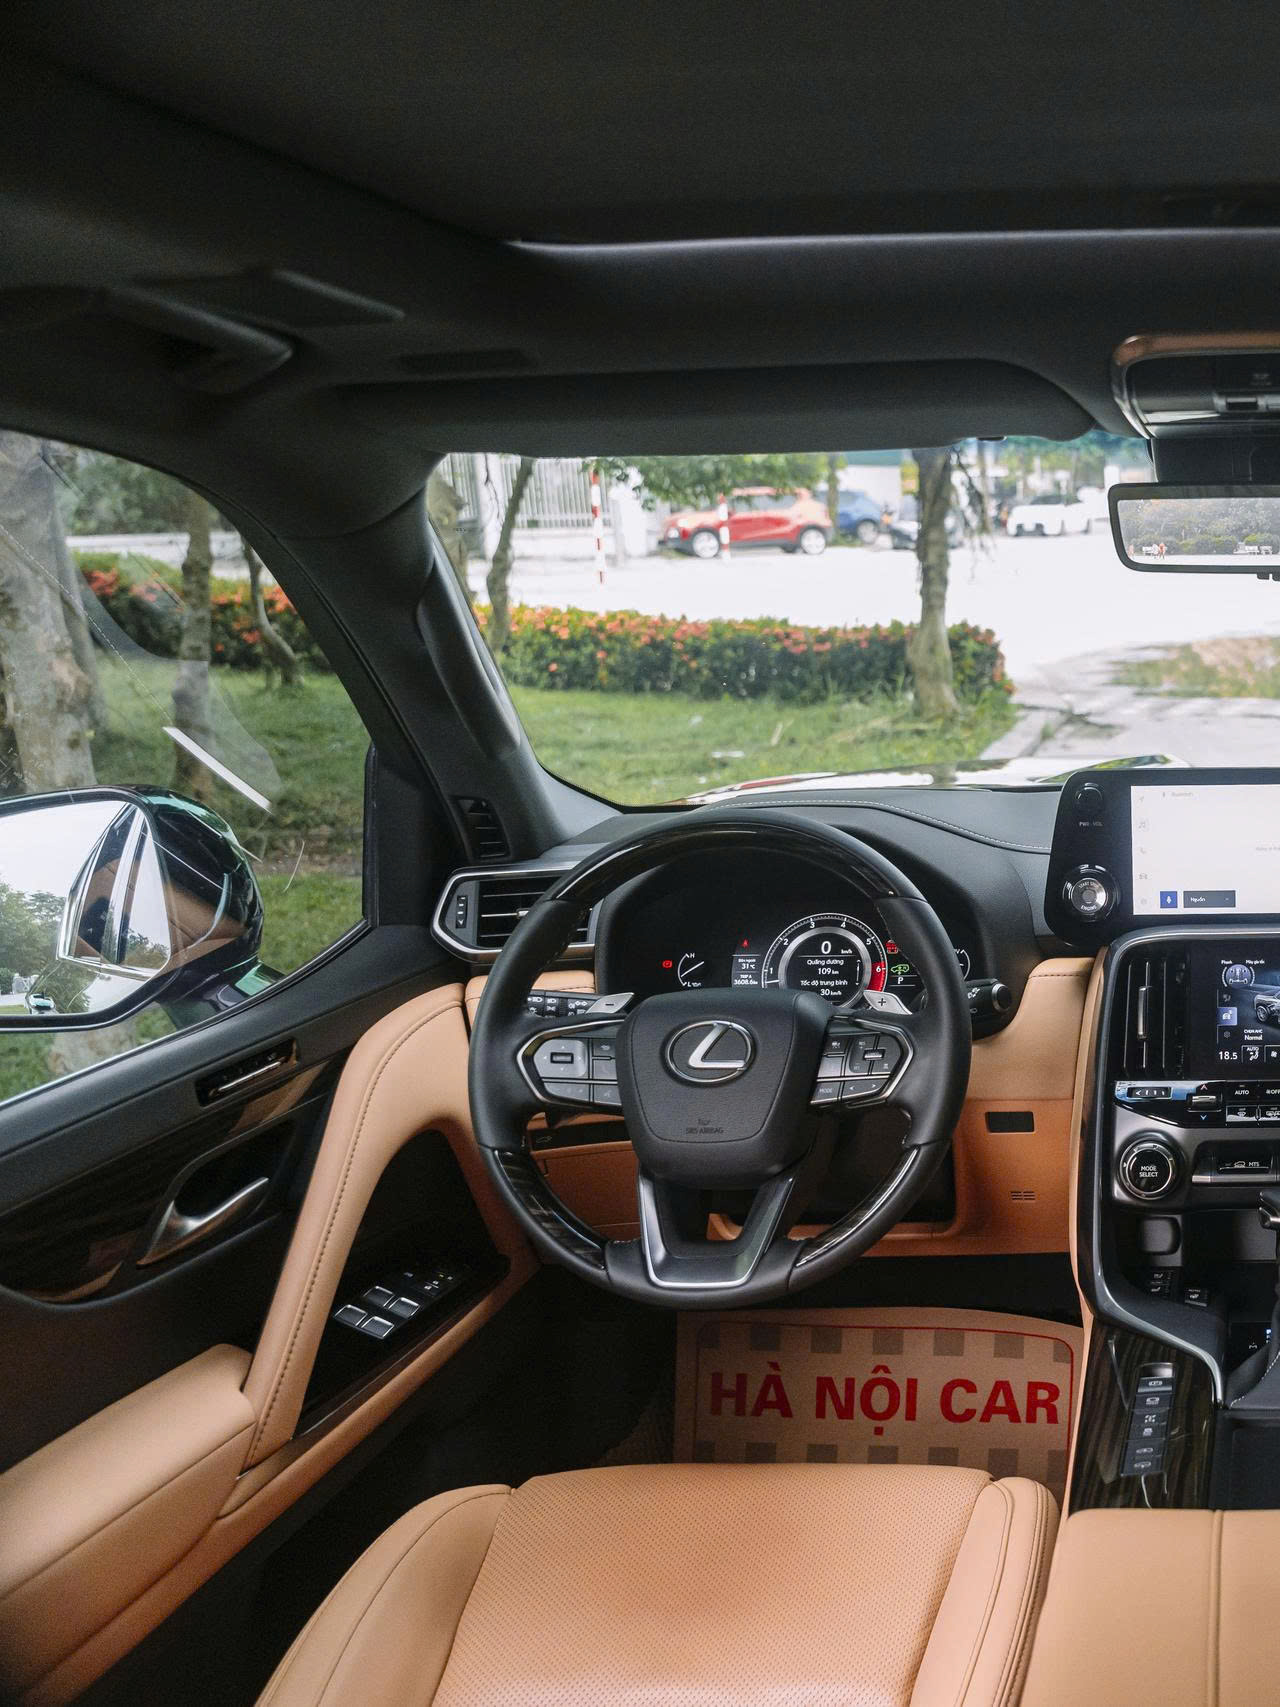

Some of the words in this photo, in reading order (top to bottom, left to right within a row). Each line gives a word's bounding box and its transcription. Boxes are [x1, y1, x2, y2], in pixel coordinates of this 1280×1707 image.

[810, 921, 815, 929] 3
[840, 921, 846, 929] 4
[783, 938, 789, 946] 2
[865, 938, 871, 946] 5
[821, 940, 832, 955] 0
[818, 967, 831, 975] 109
[820, 988, 830, 996] 30
[1218, 1051, 1238, 1060] 18.5
[710, 1361, 793, 1419] HÀ
[815, 1364, 918, 1436] NỘI
[939, 1378, 1061, 1425] CAR
